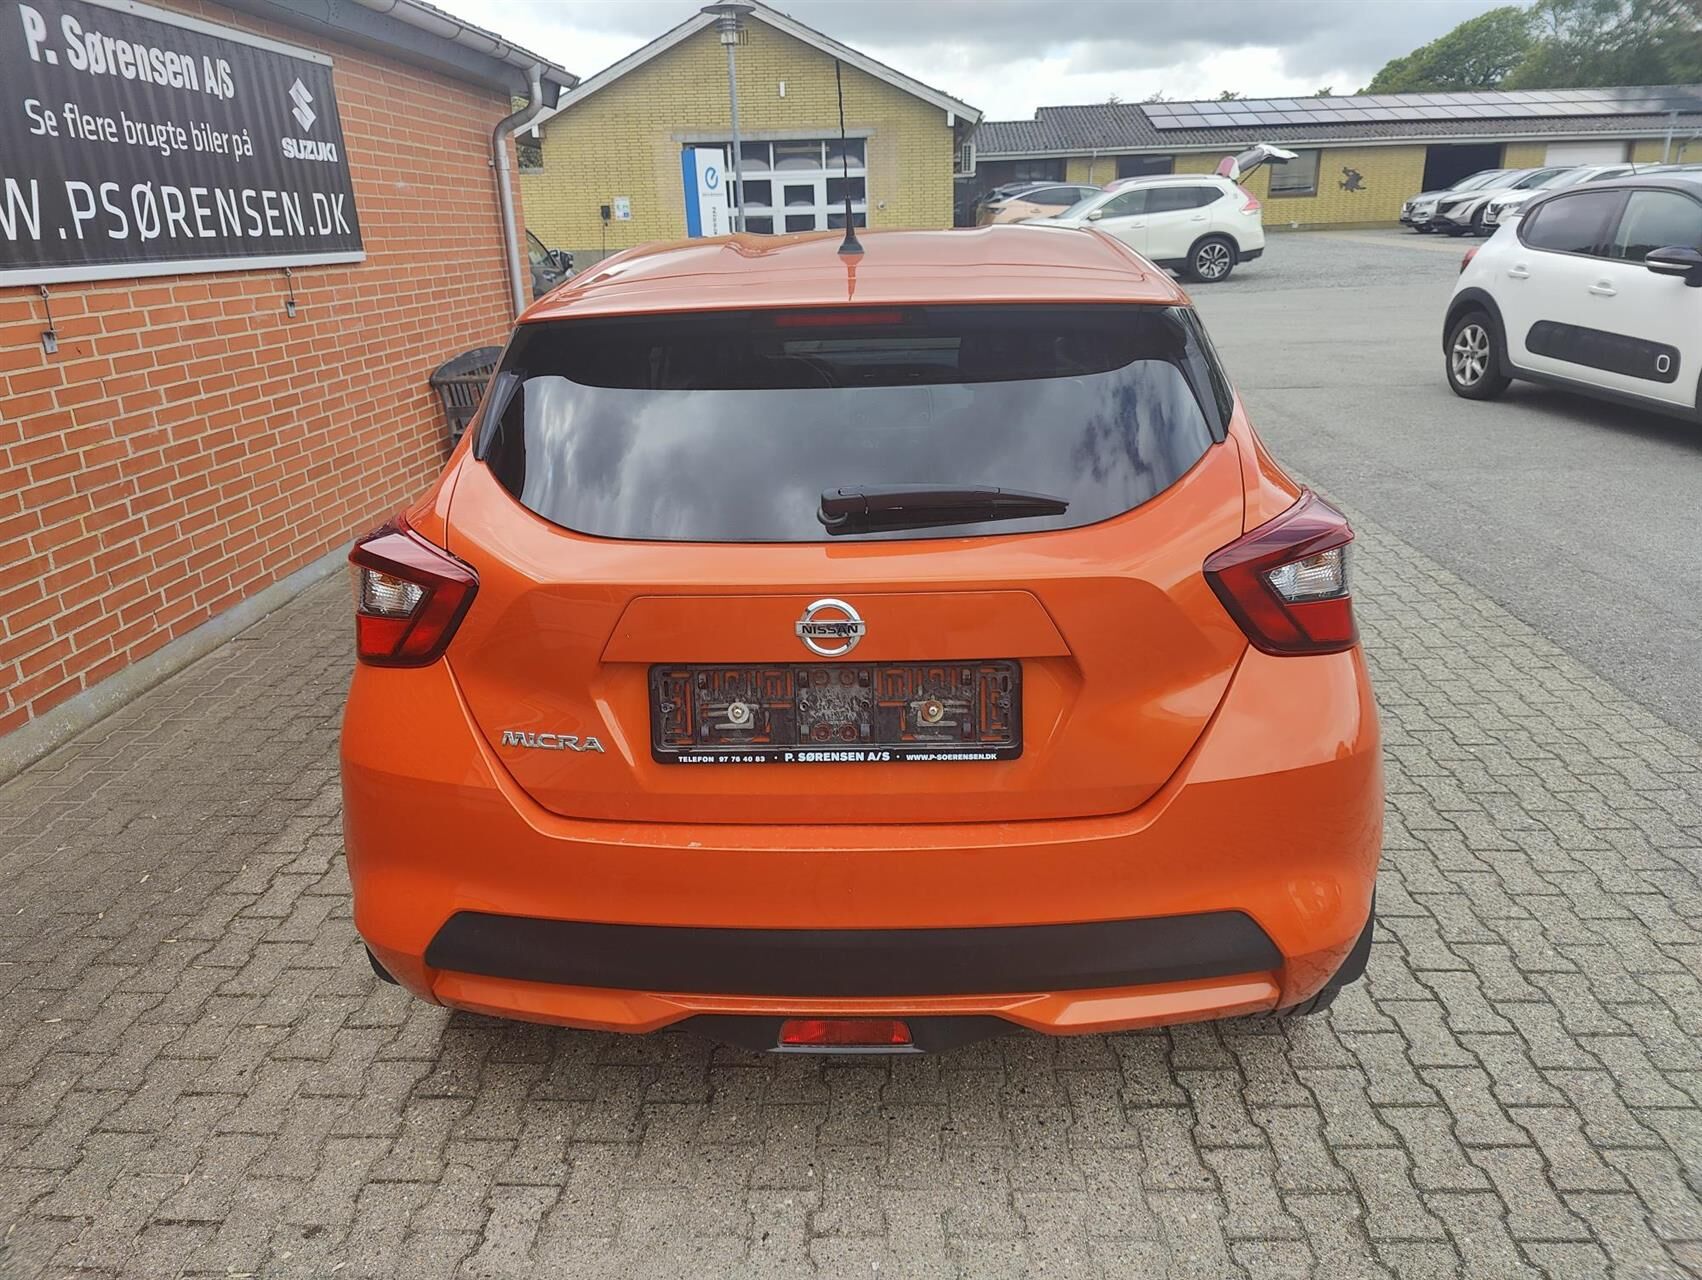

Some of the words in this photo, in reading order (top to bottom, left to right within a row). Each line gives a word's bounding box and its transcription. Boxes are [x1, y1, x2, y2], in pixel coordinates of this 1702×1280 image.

[18, 4, 59, 65] P.
[60, 13, 199, 91] Sørensen
[203, 55, 235, 100] A/S
[24, 99, 59, 137] Se
[63, 102, 118, 143] flere
[120, 111, 188, 157] brugte
[190, 122, 229, 154] biler
[233, 129, 254, 162] på
[281, 136, 338, 162] SUZUKI
[802, 625, 858, 635] NISSAN
[784, 752, 795, 762] P.
[797, 751, 865, 762] SØRENSEN
[867, 751, 890, 761] A/S
[906, 753, 997, 761] WWW.P-SOERENSEN.DK
